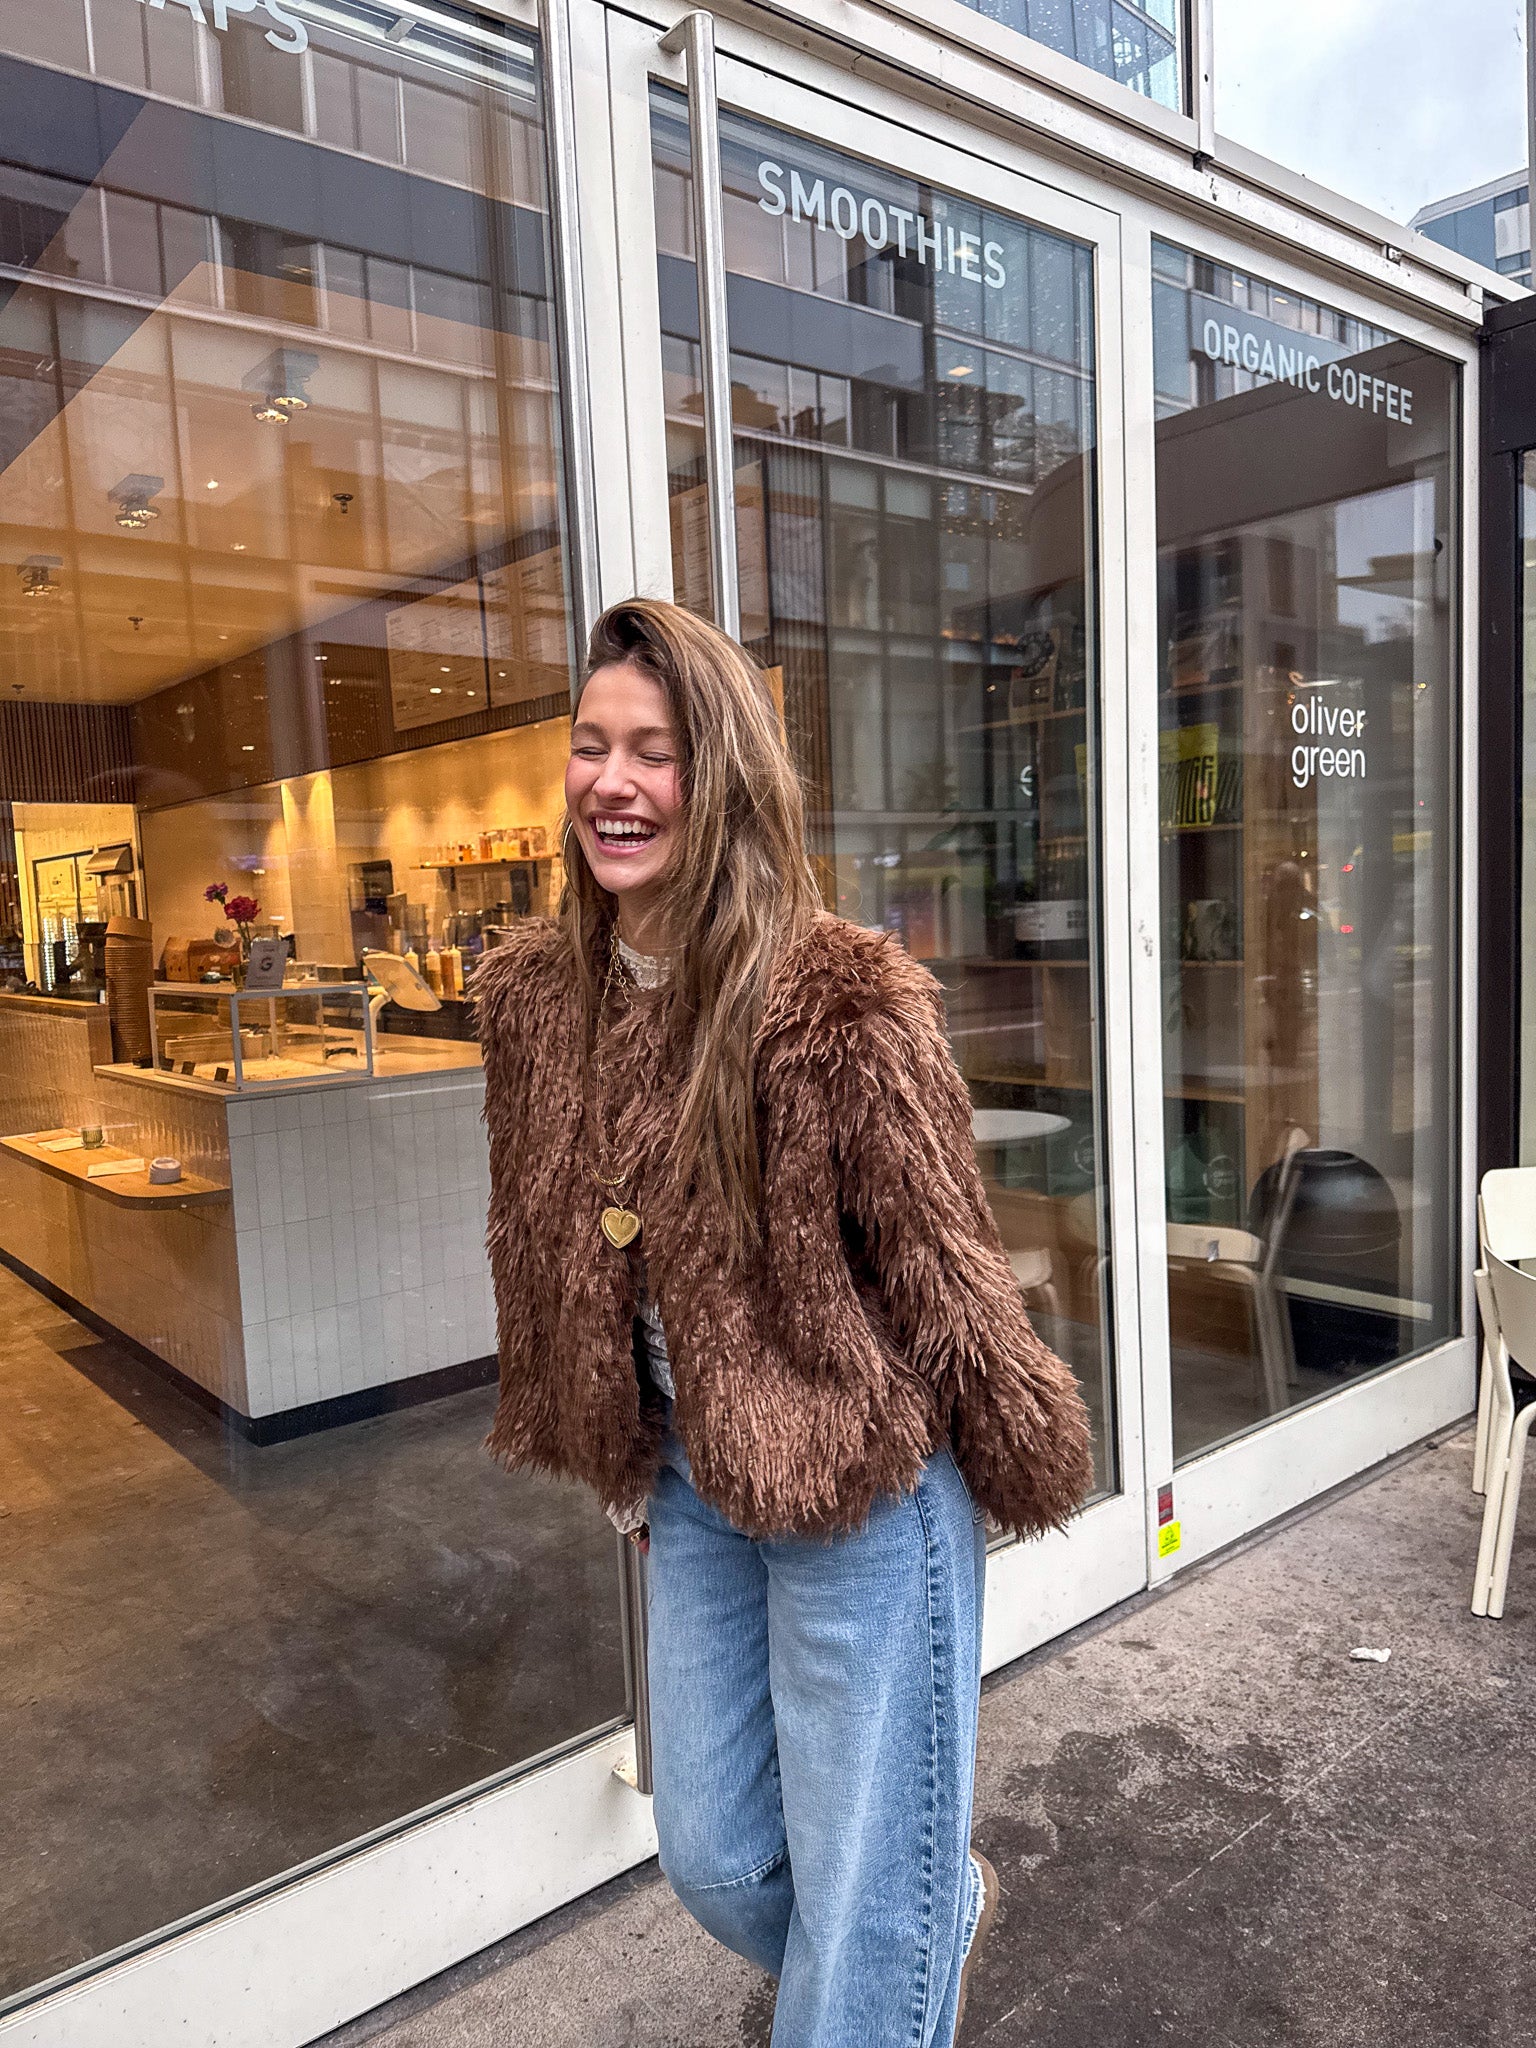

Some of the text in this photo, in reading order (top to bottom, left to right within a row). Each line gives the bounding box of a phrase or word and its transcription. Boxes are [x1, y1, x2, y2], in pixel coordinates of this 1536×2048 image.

[758, 160, 1006, 289] SMOOTHIES
[1203, 318, 1413, 425] ORGANIC COFFEE
[1291, 695, 1366, 738] oliver
[1291, 745, 1366, 788] green
